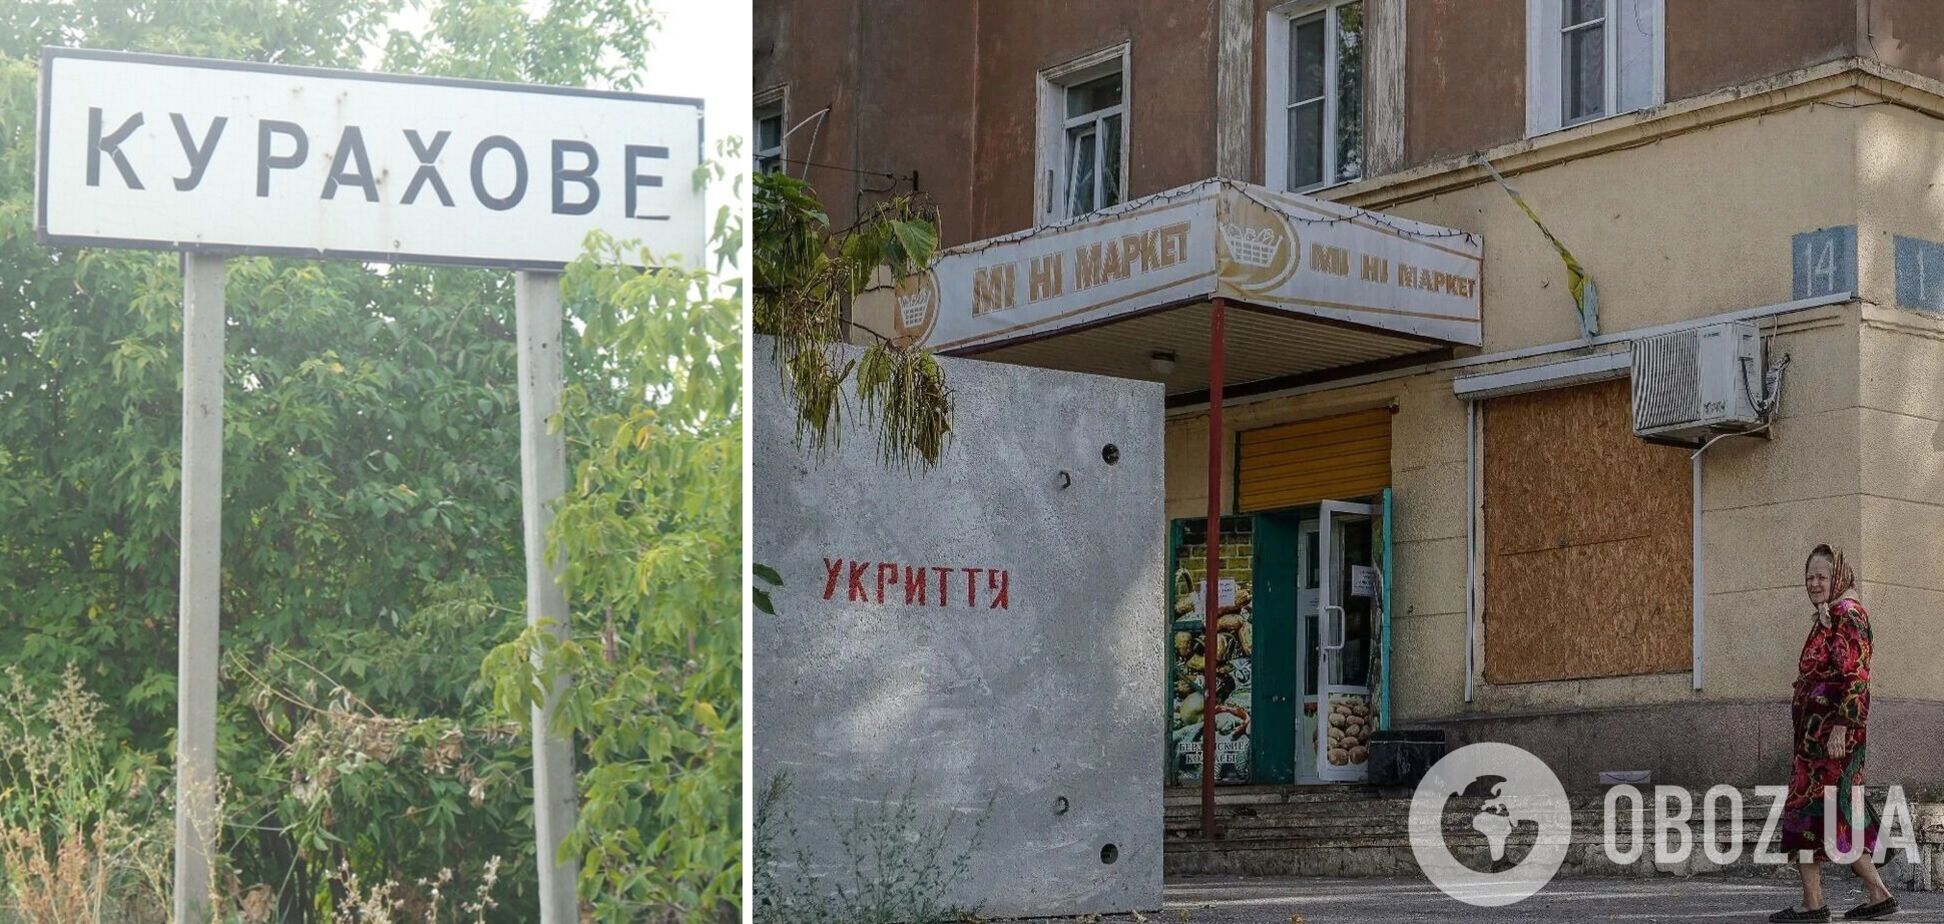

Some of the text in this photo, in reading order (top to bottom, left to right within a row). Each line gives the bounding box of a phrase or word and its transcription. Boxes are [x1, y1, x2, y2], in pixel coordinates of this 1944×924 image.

[86, 106, 670, 221] КУРАХОВЕ
[1074, 220, 1190, 292] МАРКЕТ
[1398, 262, 1476, 299] МАРКЕТ
[1805, 238, 1837, 297] 14
[823, 558, 1009, 610] УКРИТТЯ
